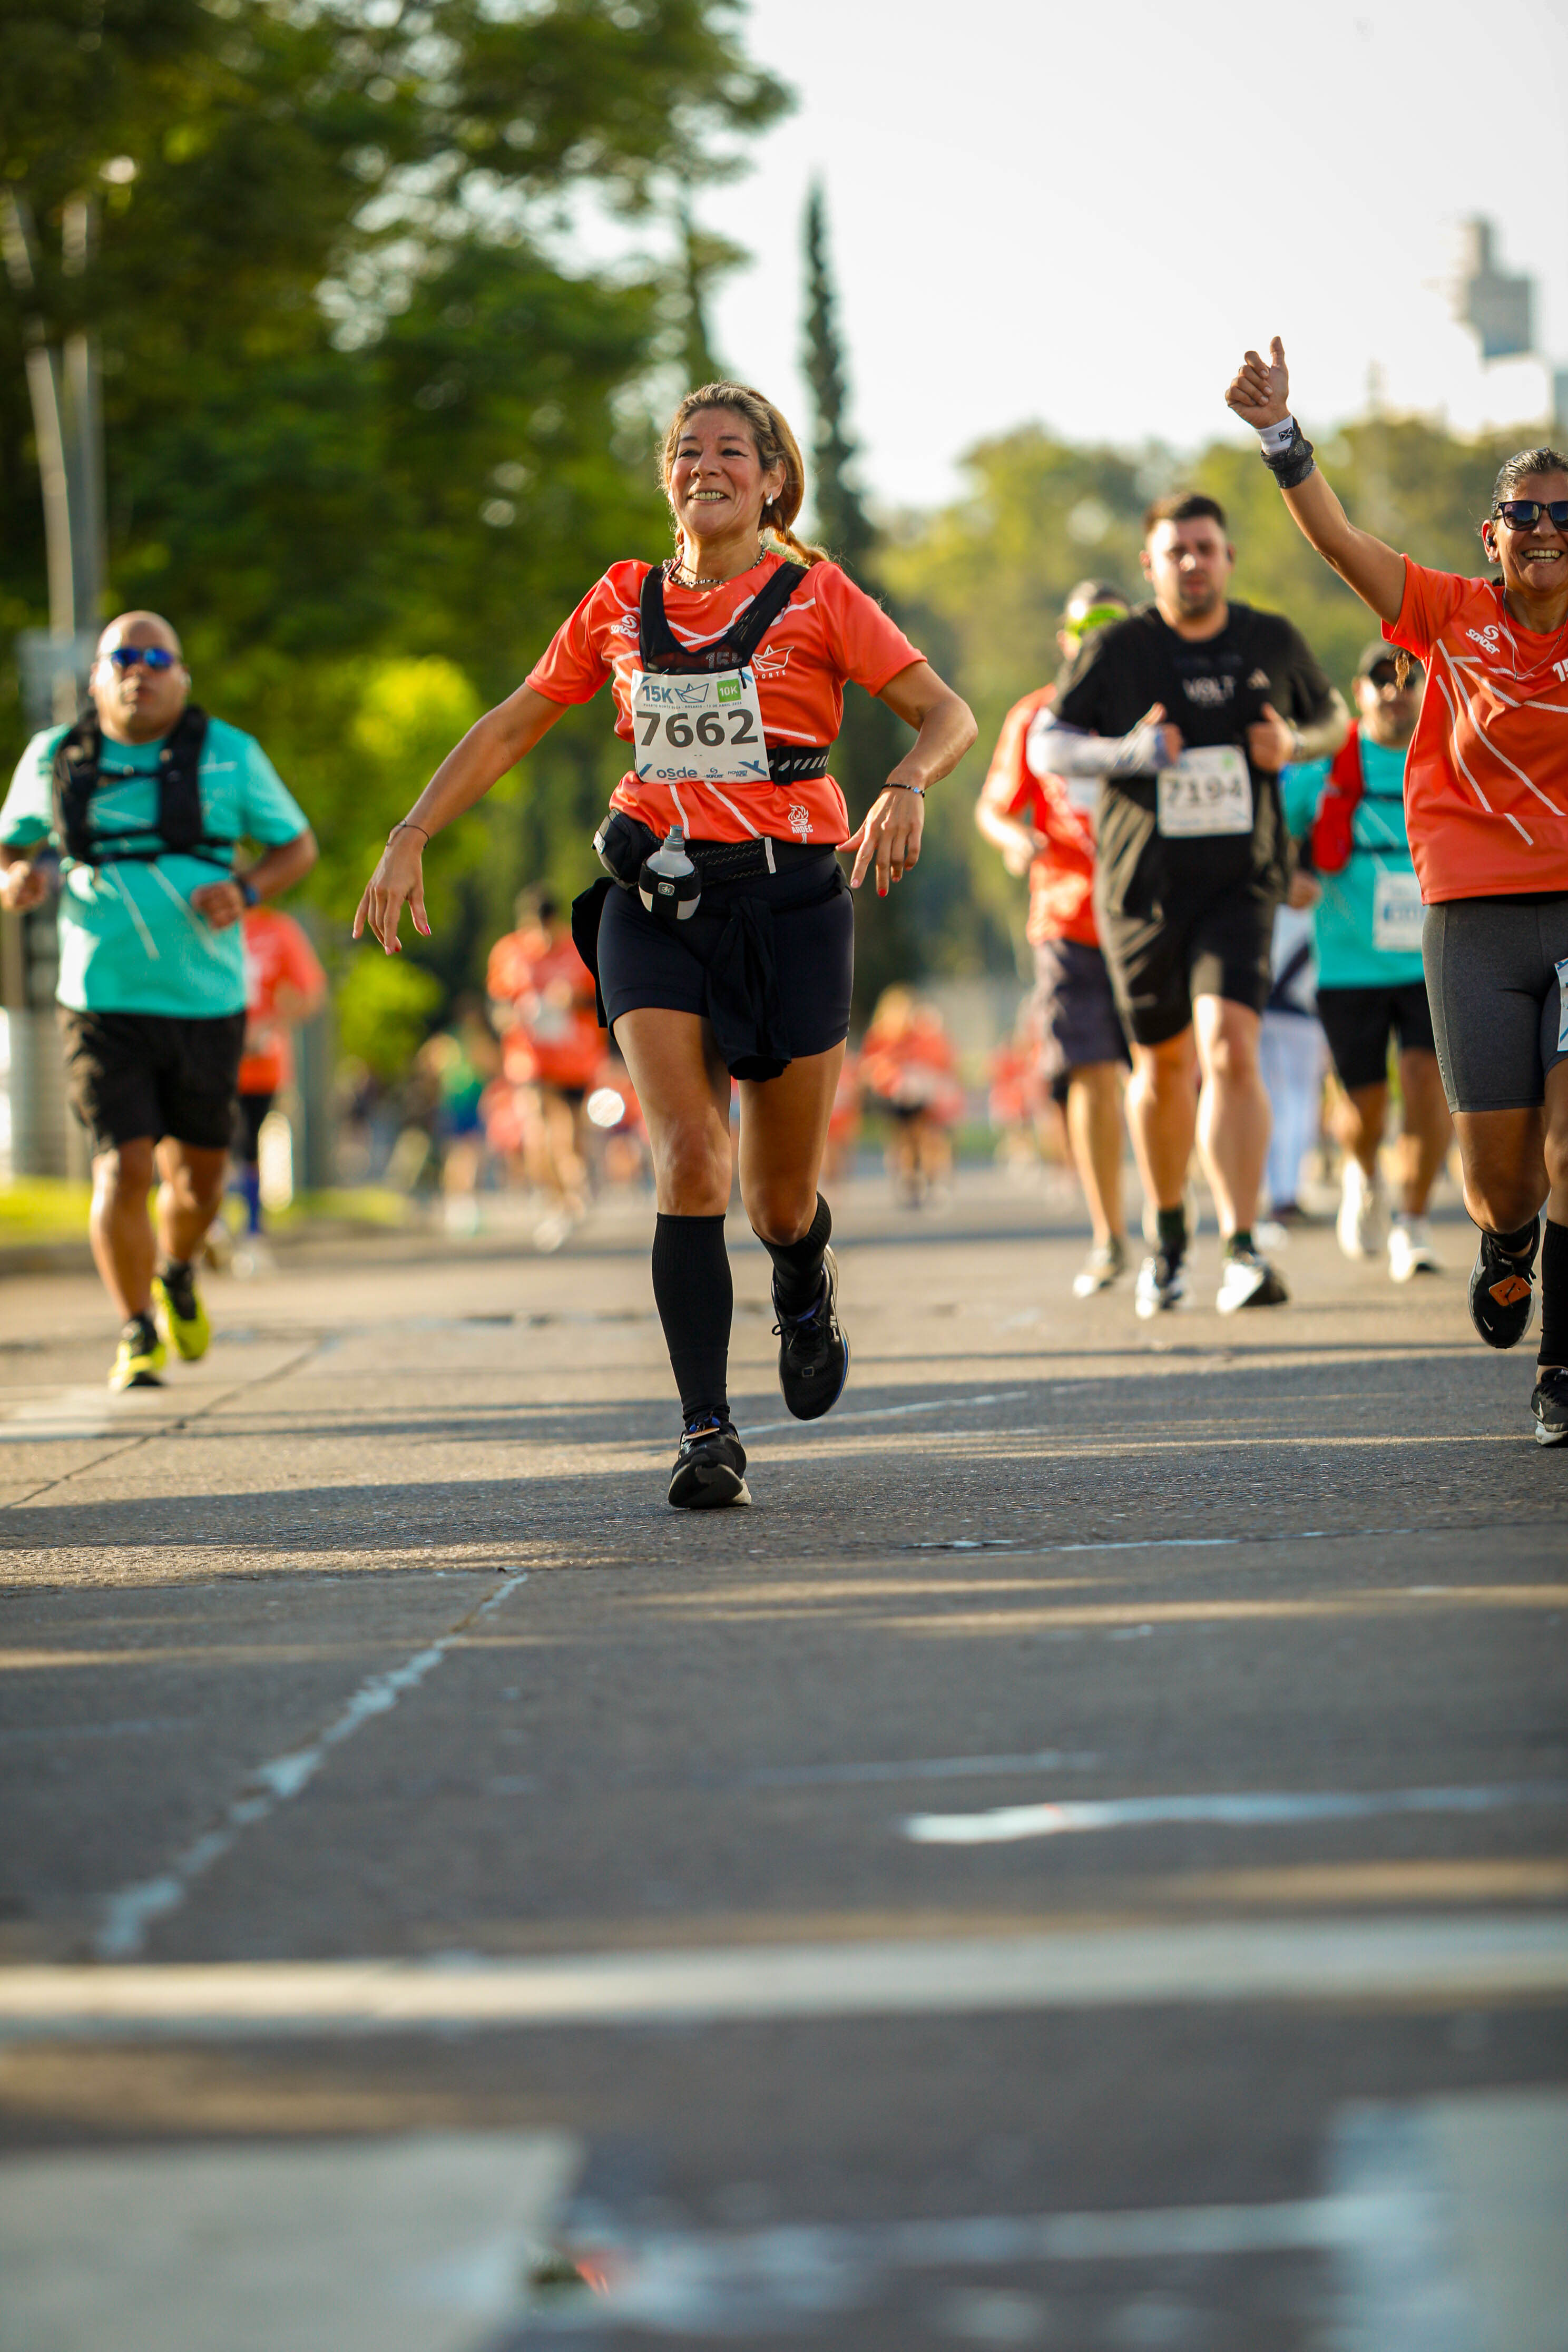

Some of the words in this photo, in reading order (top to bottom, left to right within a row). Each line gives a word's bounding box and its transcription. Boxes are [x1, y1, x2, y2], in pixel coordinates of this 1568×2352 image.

[754, 670, 786, 679] NORTE
[642, 685, 674, 703] 15K
[720, 685, 738, 696] 10K
[636, 709, 758, 748] 7662
[656, 766, 698, 779] osde
[791, 824, 813, 834] ARDEC
